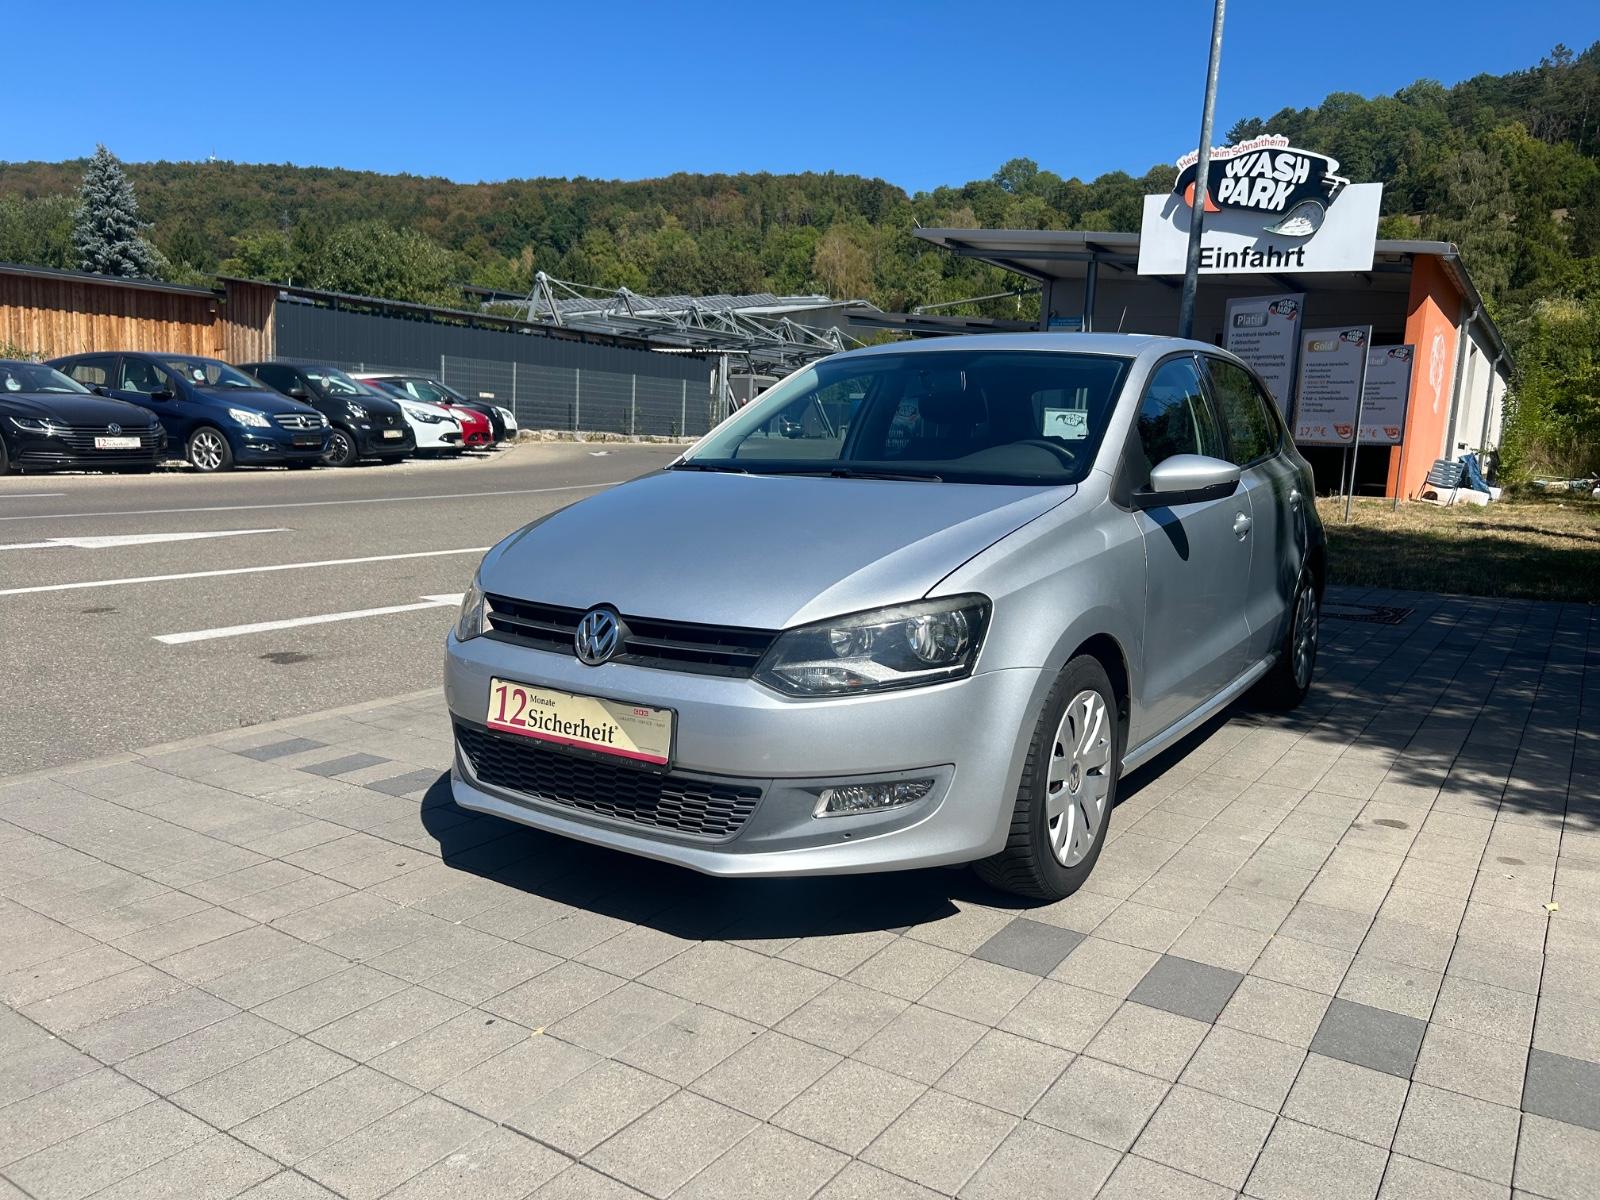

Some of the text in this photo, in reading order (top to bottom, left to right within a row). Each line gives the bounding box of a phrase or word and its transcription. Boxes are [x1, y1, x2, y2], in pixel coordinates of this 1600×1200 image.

[1179, 138, 1286, 169] Heiheim Schnaitheim
[1225, 151, 1311, 185] WASH
[1217, 177, 1296, 211] PARK
[1198, 245, 1305, 268] Einfahrt
[1237, 314, 1263, 326] Platin
[1313, 342, 1333, 351] Gold
[493, 685, 556, 727] 12 Monate
[527, 708, 616, 744] Sicherheit
